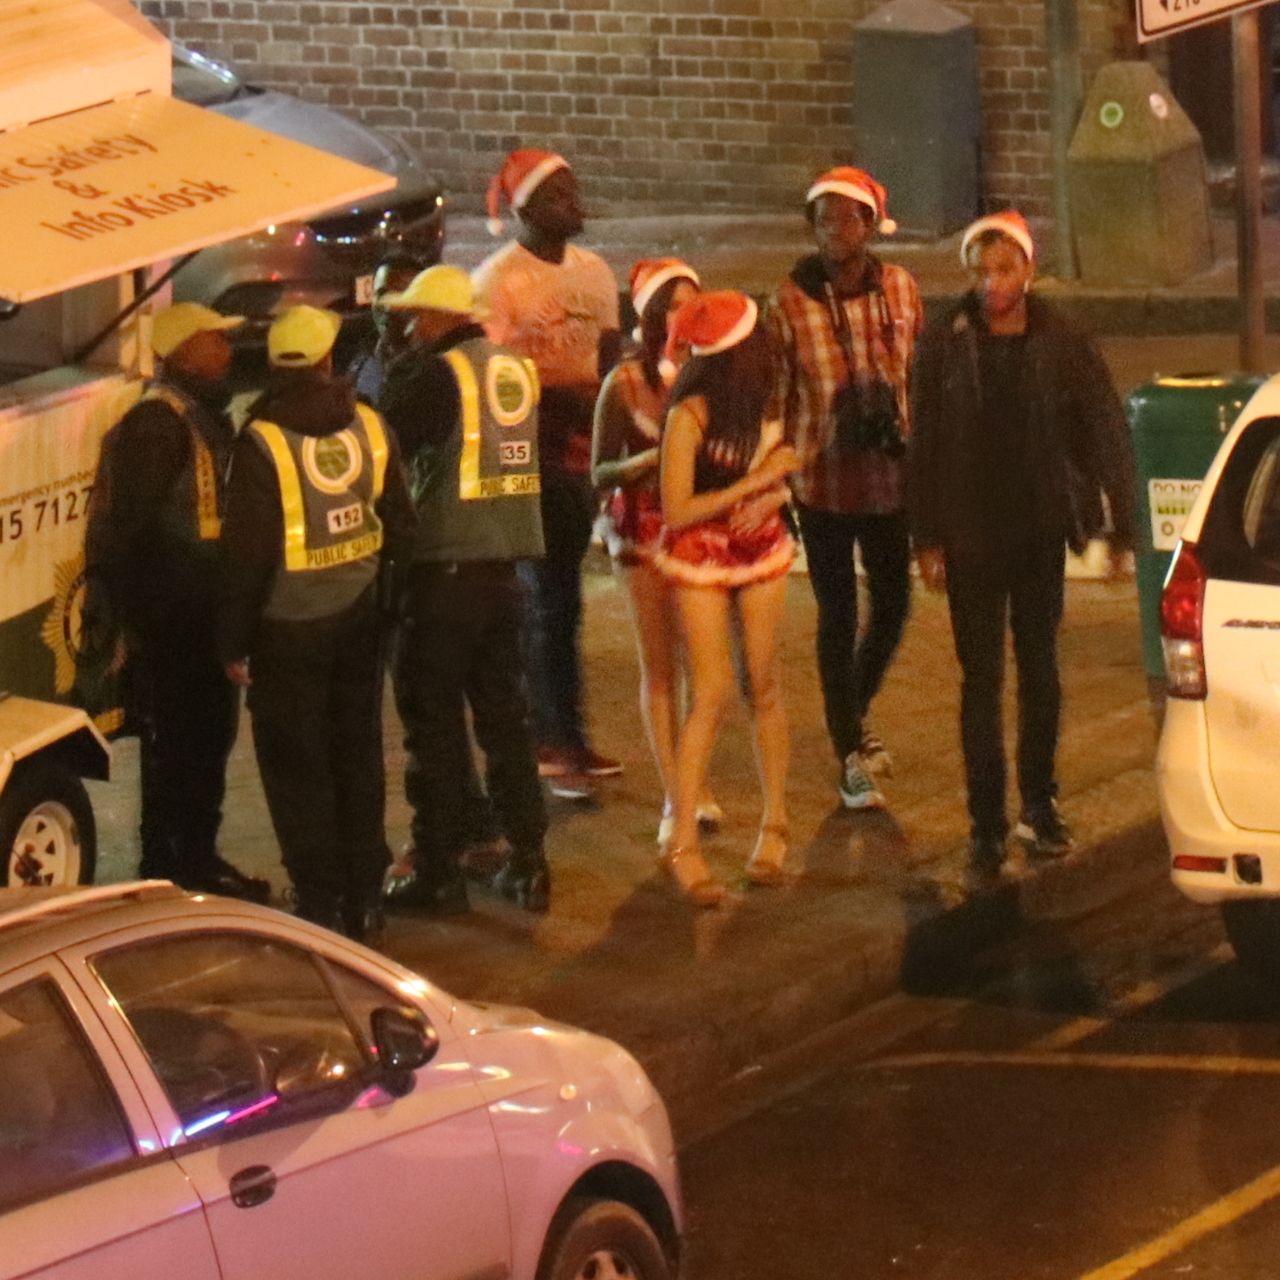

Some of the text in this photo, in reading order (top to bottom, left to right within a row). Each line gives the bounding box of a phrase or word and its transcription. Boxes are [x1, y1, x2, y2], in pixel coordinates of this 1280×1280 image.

[16, 133, 158, 177] Safety
[51, 178, 111, 200] &
[39, 176, 239, 241] Info Kiosk
[33, 484, 98, 532] 7127
[333, 506, 360, 528] 152
[306, 543, 347, 566] PUBLIC
